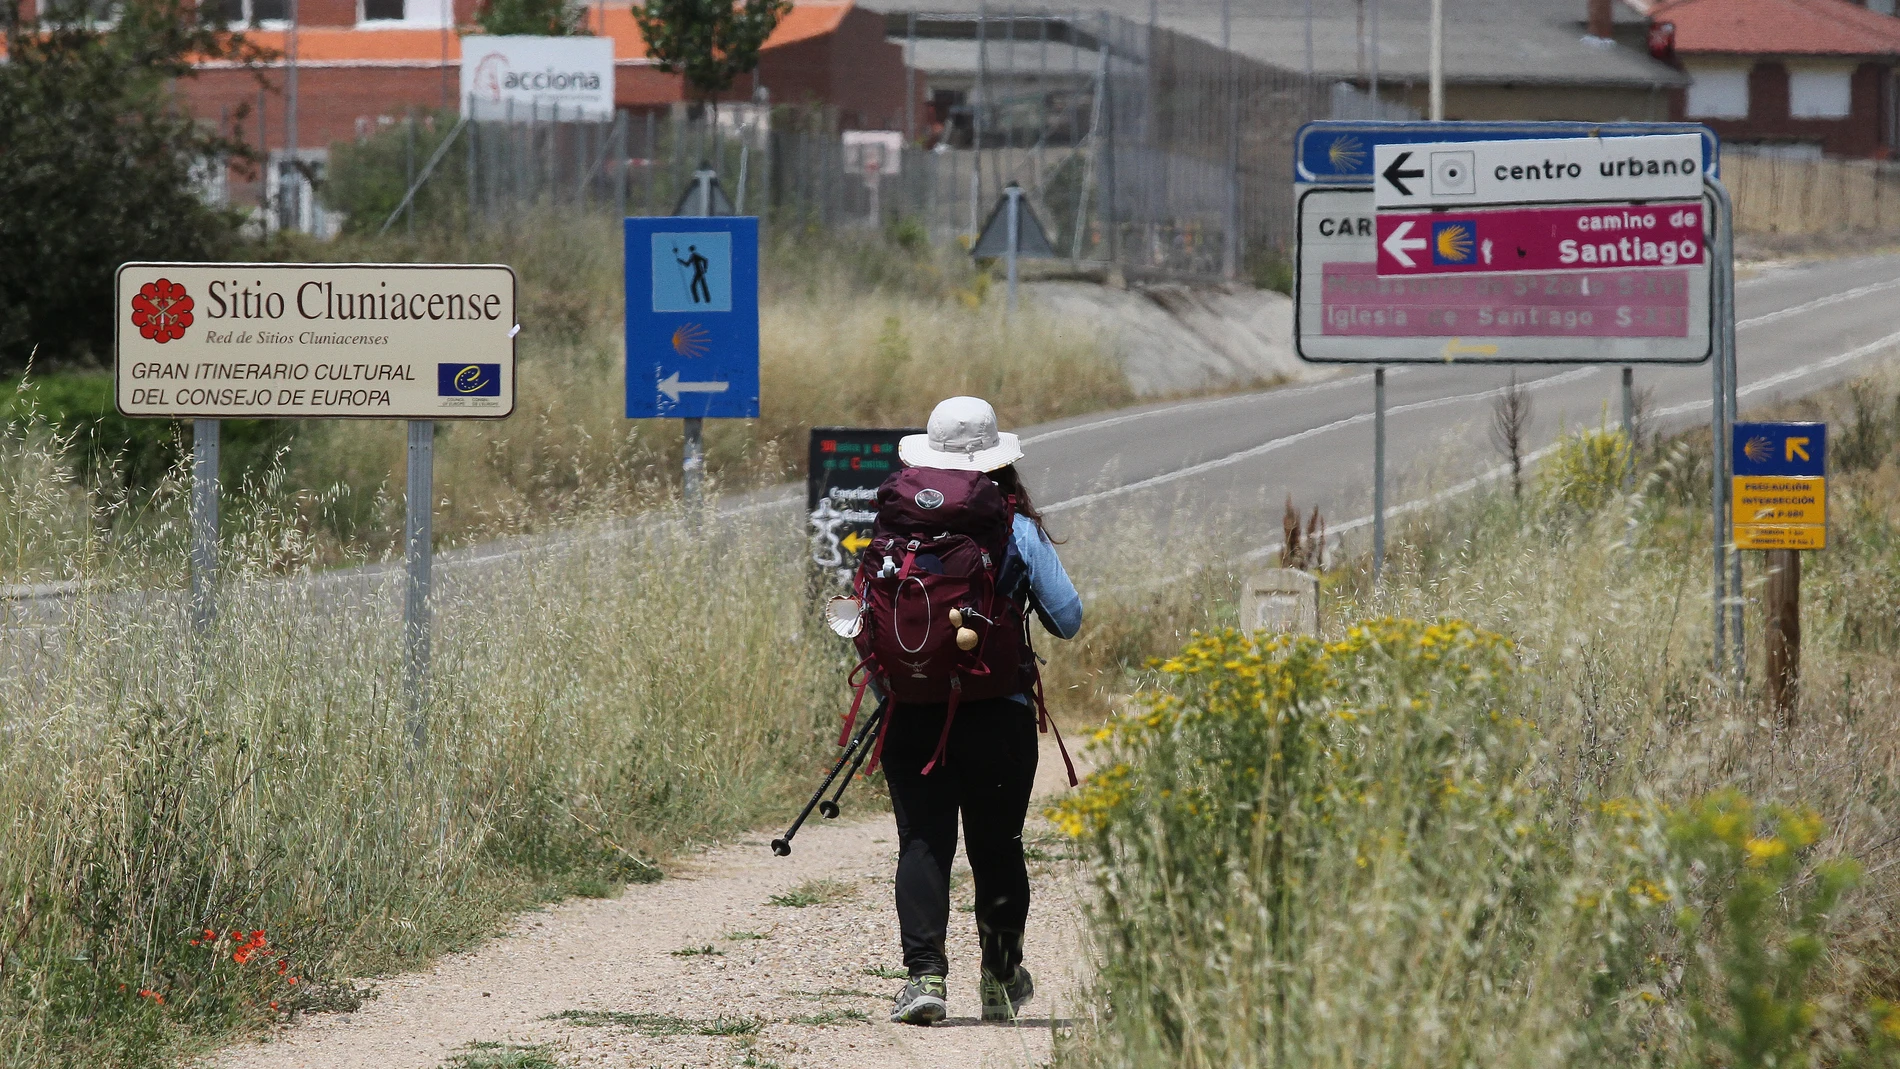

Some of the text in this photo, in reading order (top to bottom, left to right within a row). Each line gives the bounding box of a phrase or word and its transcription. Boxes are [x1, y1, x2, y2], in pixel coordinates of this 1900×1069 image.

[504, 65, 600, 90] acciona
[1494, 156, 1696, 181] centro urbano
[1577, 209, 1697, 231] camino de
[1558, 236, 1698, 265] Santiago
[206, 280, 502, 321] Sitio Cluniacense
[1328, 305, 1407, 329] Iglesia
[1428, 309, 1458, 326] de
[1479, 305, 1594, 329] Santiago
[205, 331, 389, 345] Red de Sitios Cluniacenses
[131, 362, 416, 381] GRAN ITINERARIO CULTURAL
[131, 389, 391, 406] DEL CONSEJO DE EUROPA
[1742, 496, 1815, 505] INTERSECCIÓN
